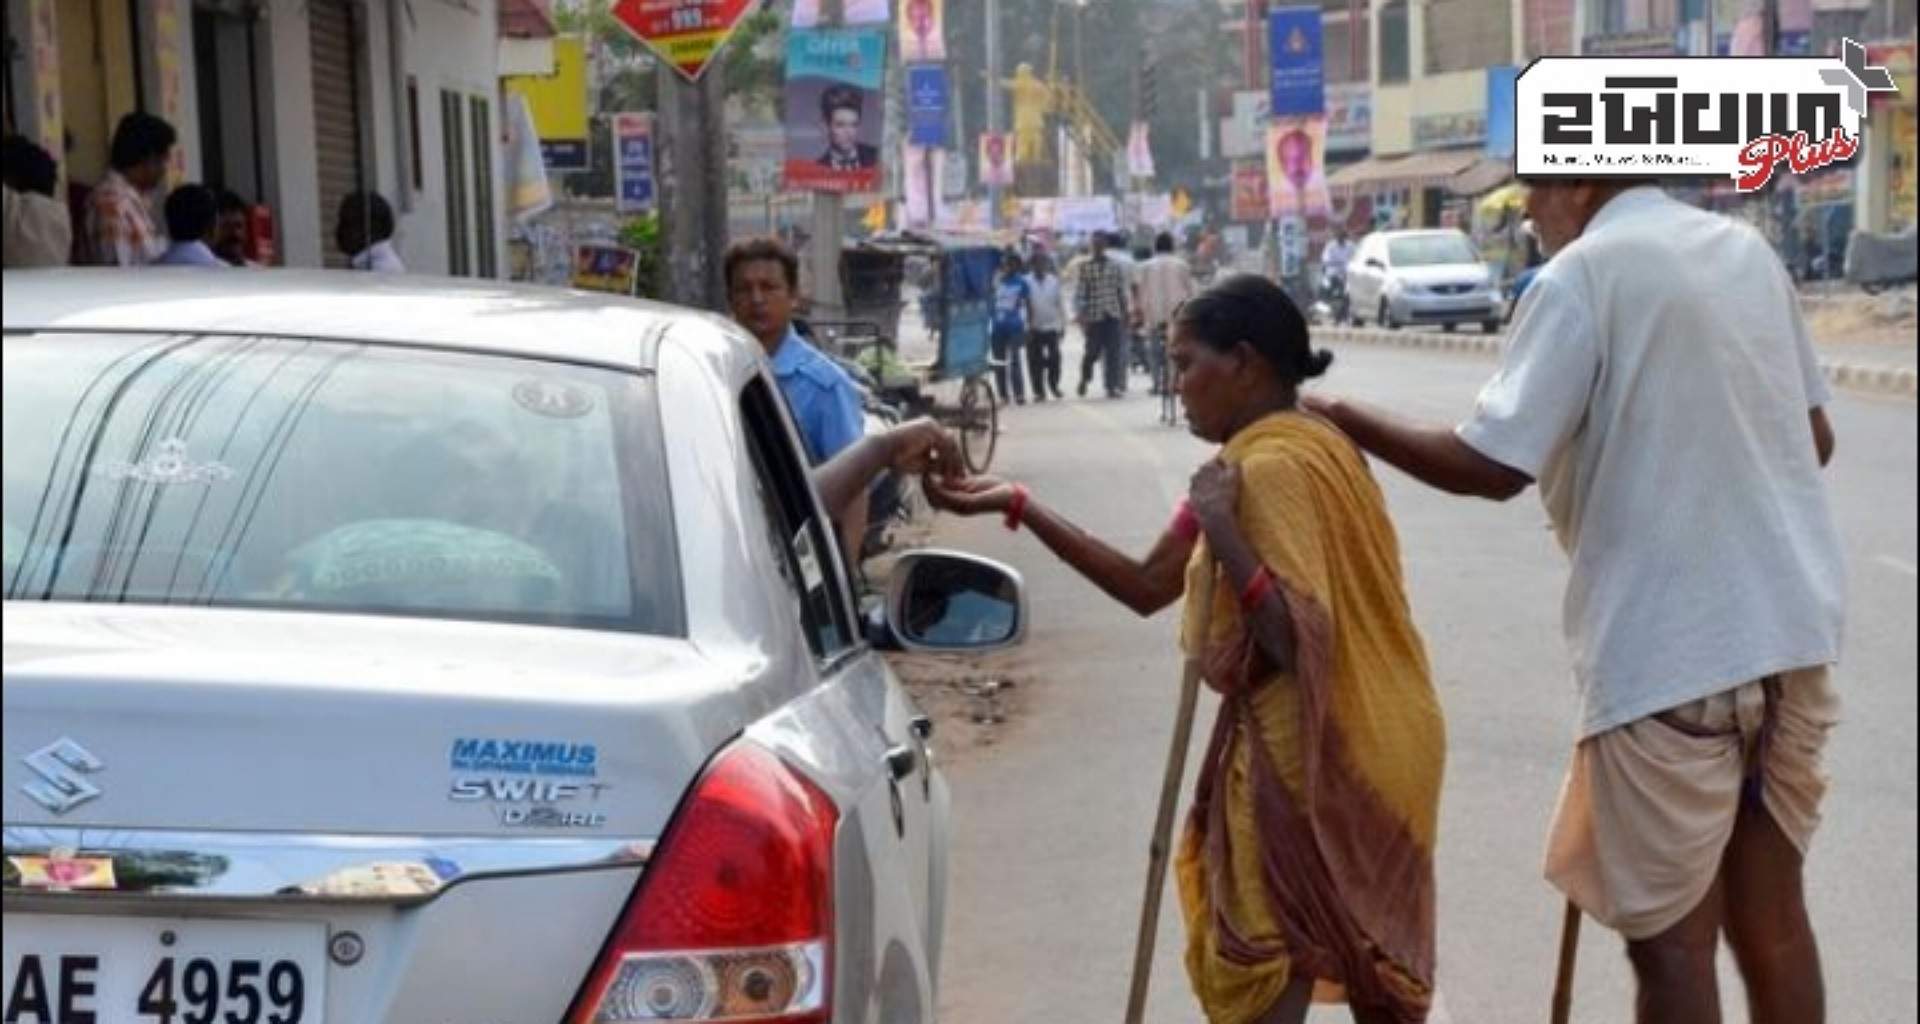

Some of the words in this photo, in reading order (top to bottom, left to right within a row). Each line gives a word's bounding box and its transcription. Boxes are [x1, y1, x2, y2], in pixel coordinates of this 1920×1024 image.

[451, 738, 598, 764] MAXIMUS
[450, 777, 611, 801] SWIFT
[4, 954, 98, 1024] AE
[137, 956, 304, 1024] 4959
